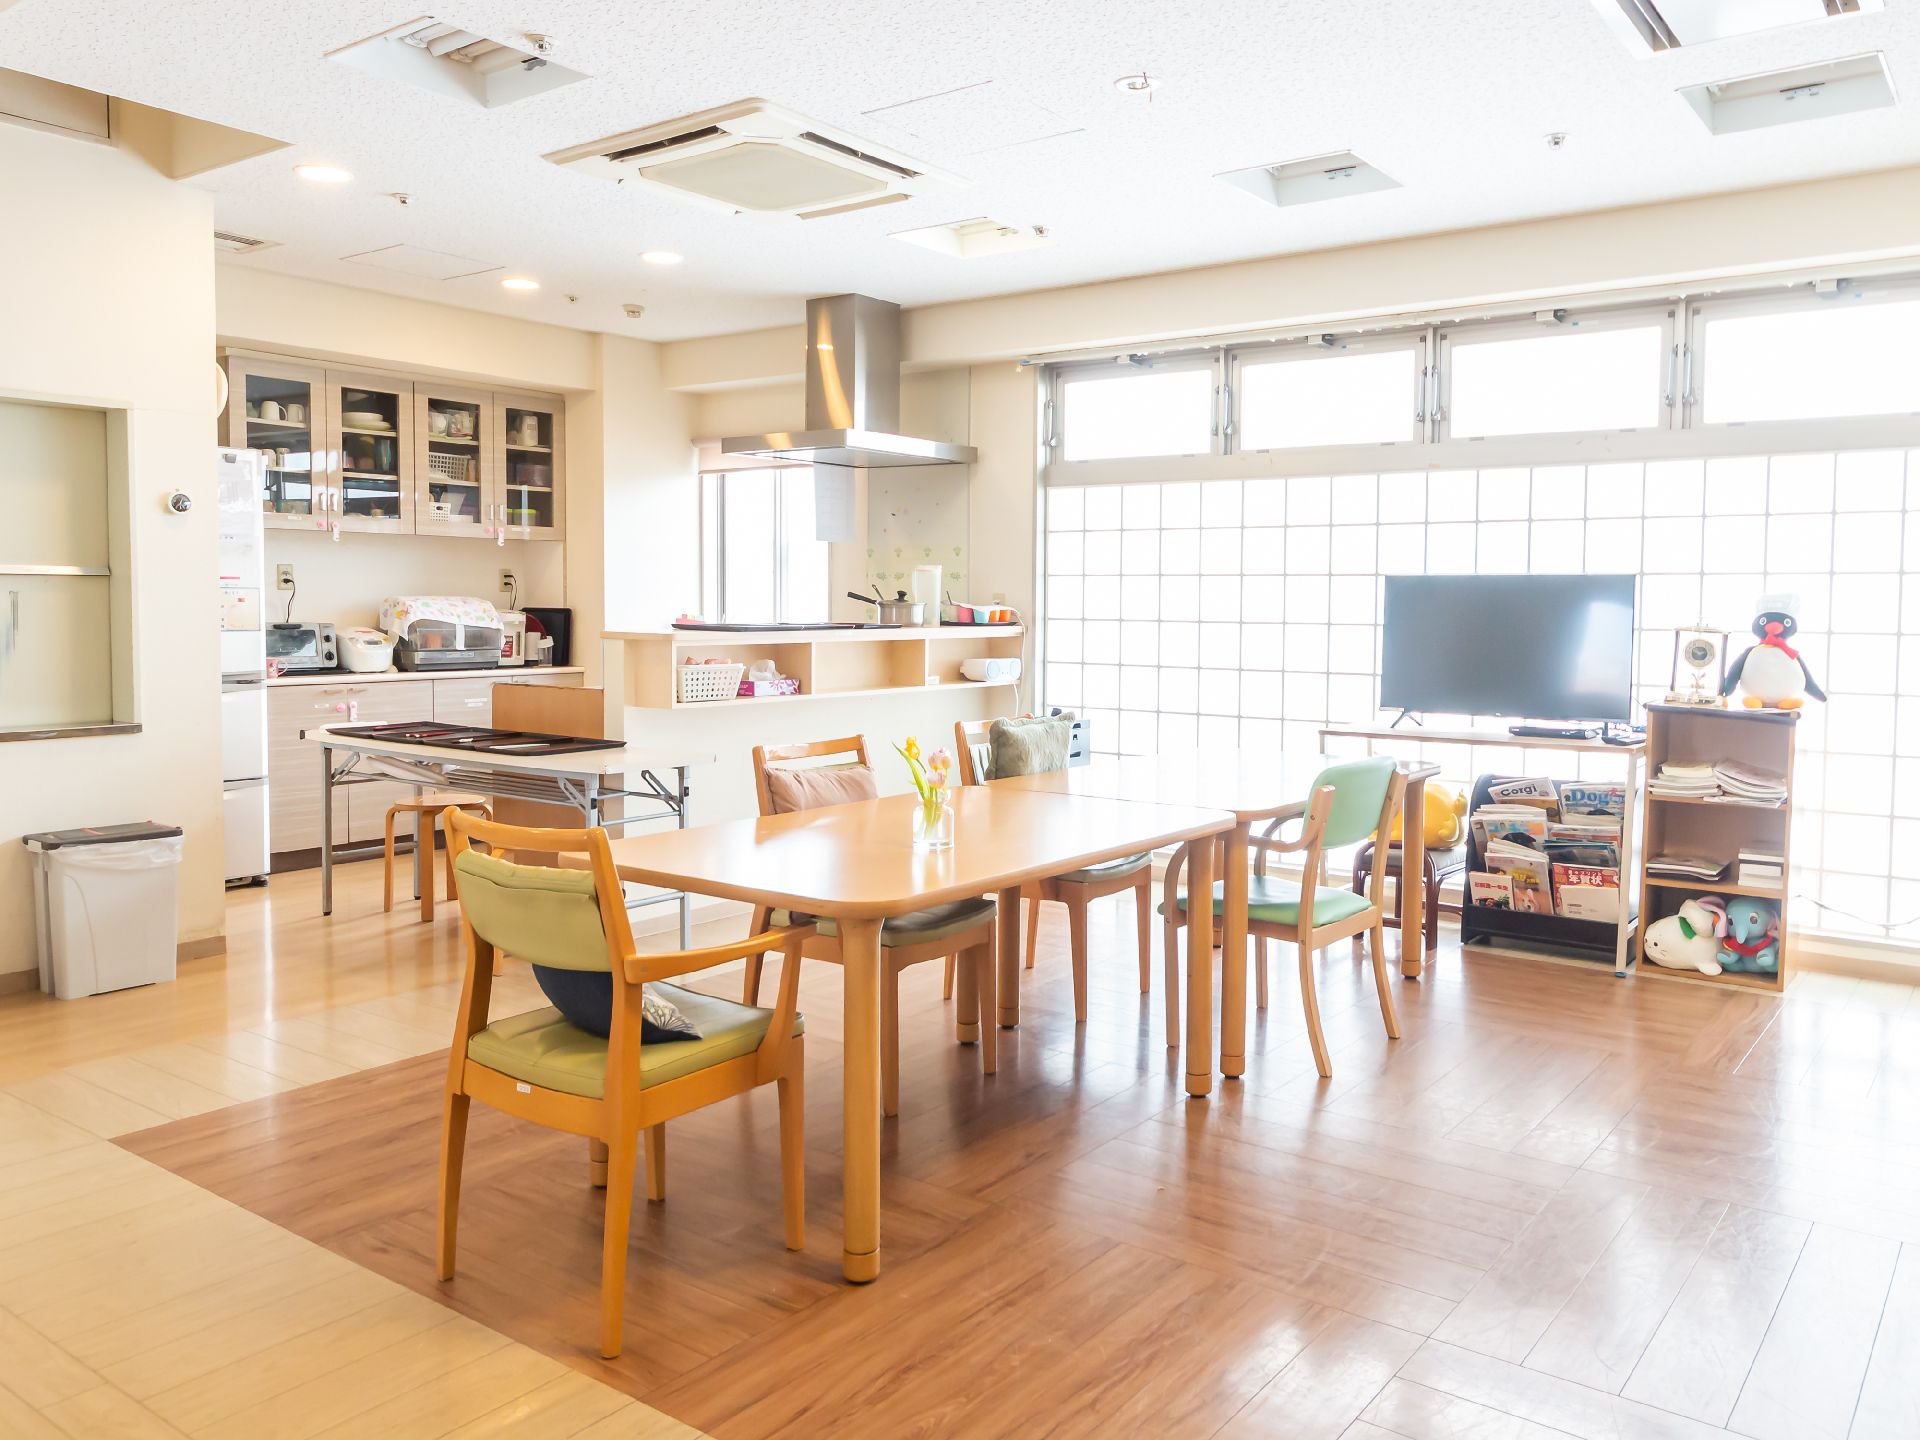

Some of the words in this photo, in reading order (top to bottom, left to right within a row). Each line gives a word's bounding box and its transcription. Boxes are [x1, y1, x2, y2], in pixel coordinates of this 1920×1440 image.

[1500, 784, 1538, 796] Corgi
[1568, 874, 1603, 885] 年賀状
